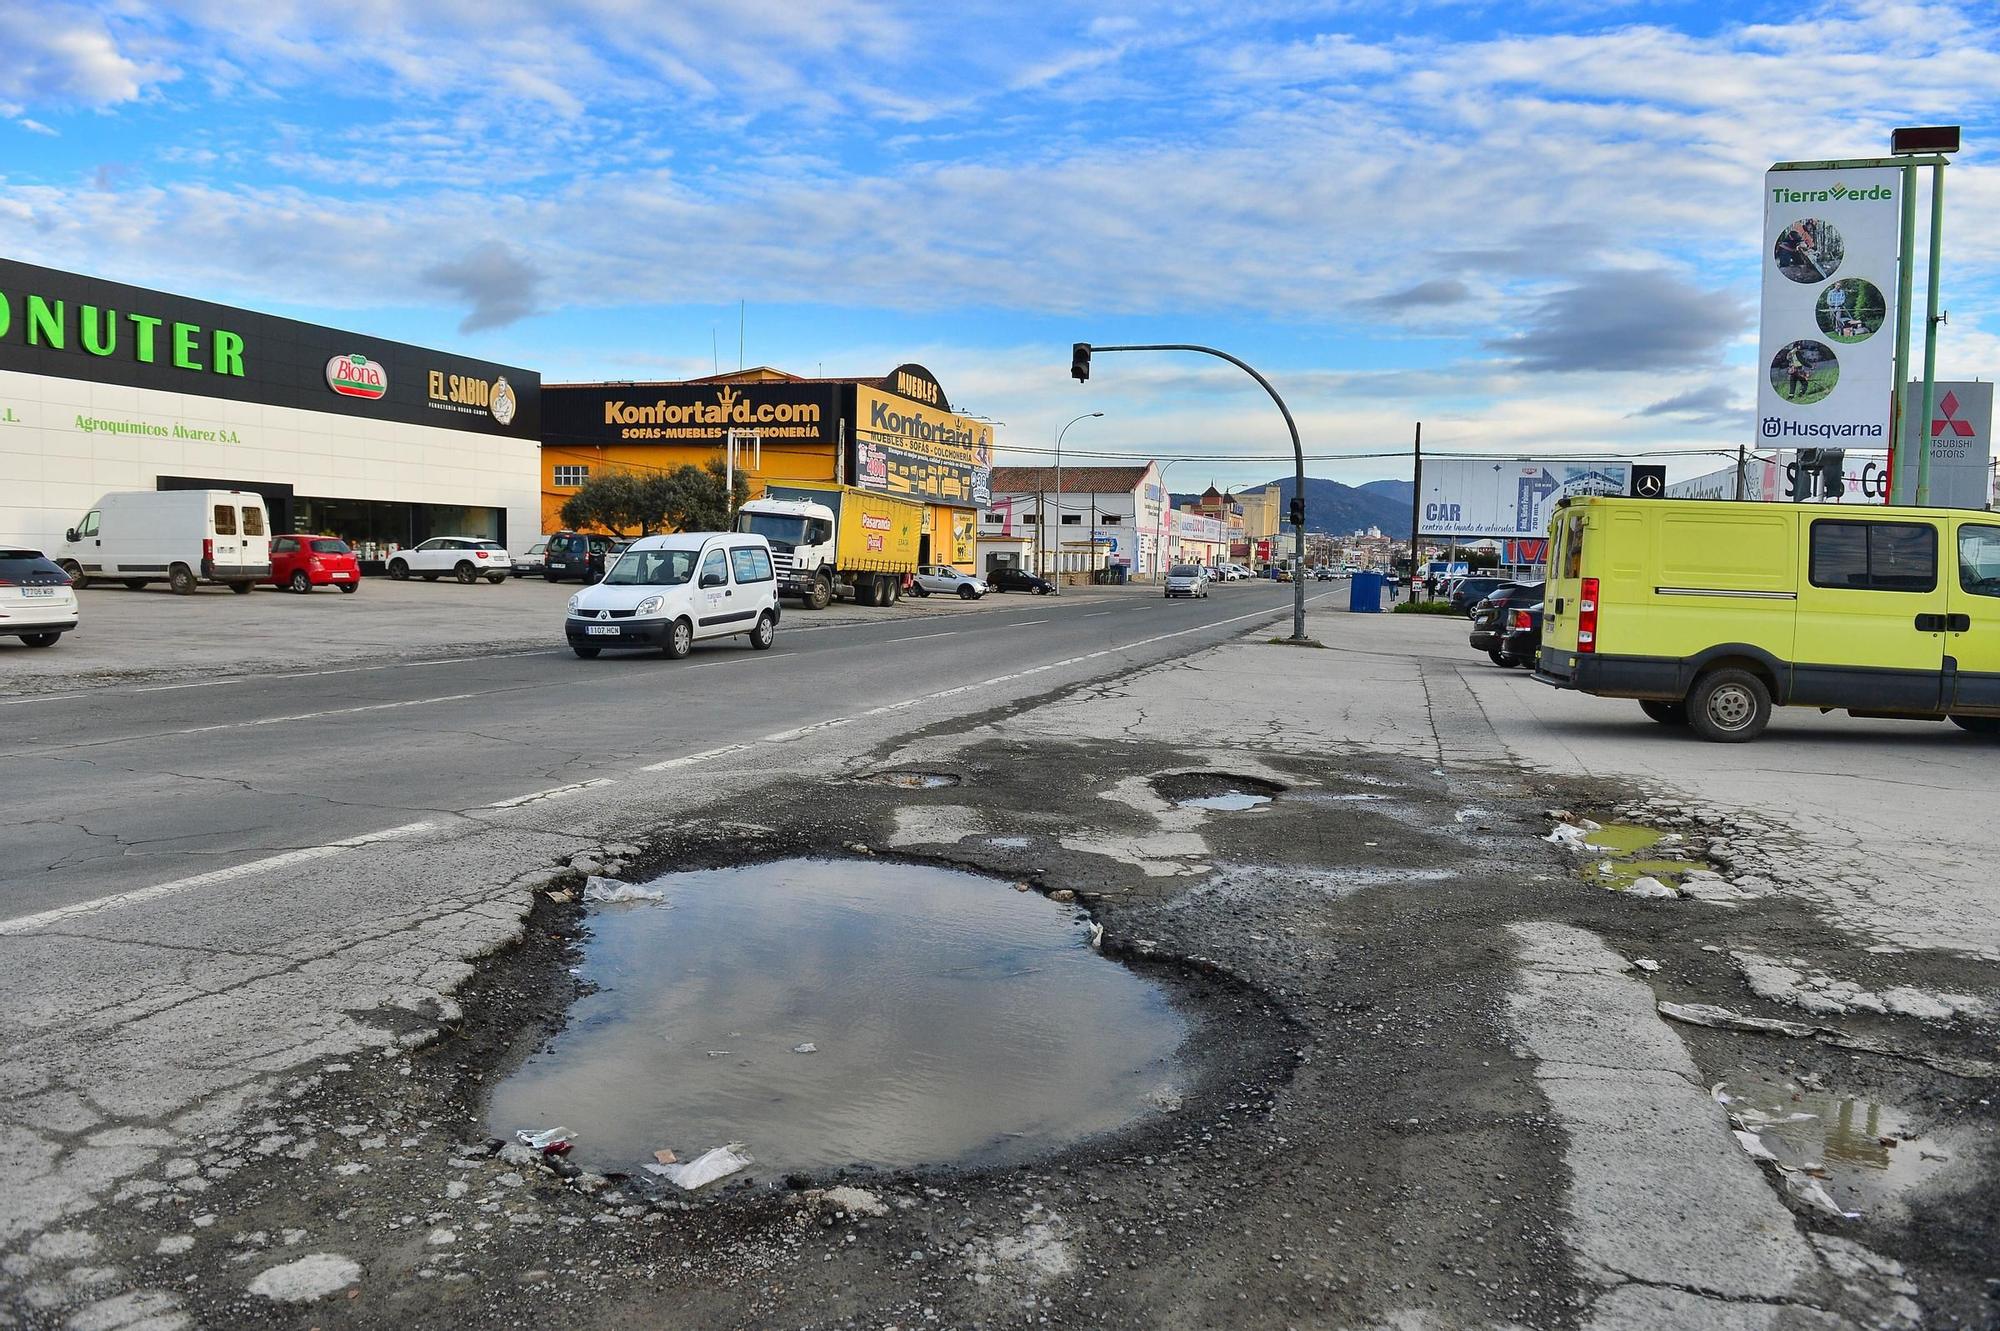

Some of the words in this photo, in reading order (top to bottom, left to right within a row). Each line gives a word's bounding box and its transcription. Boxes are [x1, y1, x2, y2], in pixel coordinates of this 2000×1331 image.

[336, 360, 381, 385] Biona
[428, 370, 448, 400] EL
[450, 374, 489, 407] SABIO
[897, 371, 938, 404] MUEBLES
[605, 400, 820, 424] Konfortard.com
[871, 400, 973, 451] Konfortard
[1783, 421, 1882, 438] Husqvarna
[219, 430, 241, 444] S.A.
[870, 432, 904, 448] MUEBLES
[1931, 440, 1972, 448] TSUBISHI
[1426, 503, 1461, 521] CAR
[1422, 523, 1443, 531] centro
[1445, 522, 1452, 531] de
[1454, 522, 1474, 532] lavado
[1475, 523, 1483, 532] de
[590, 626, 605, 635] 1107
